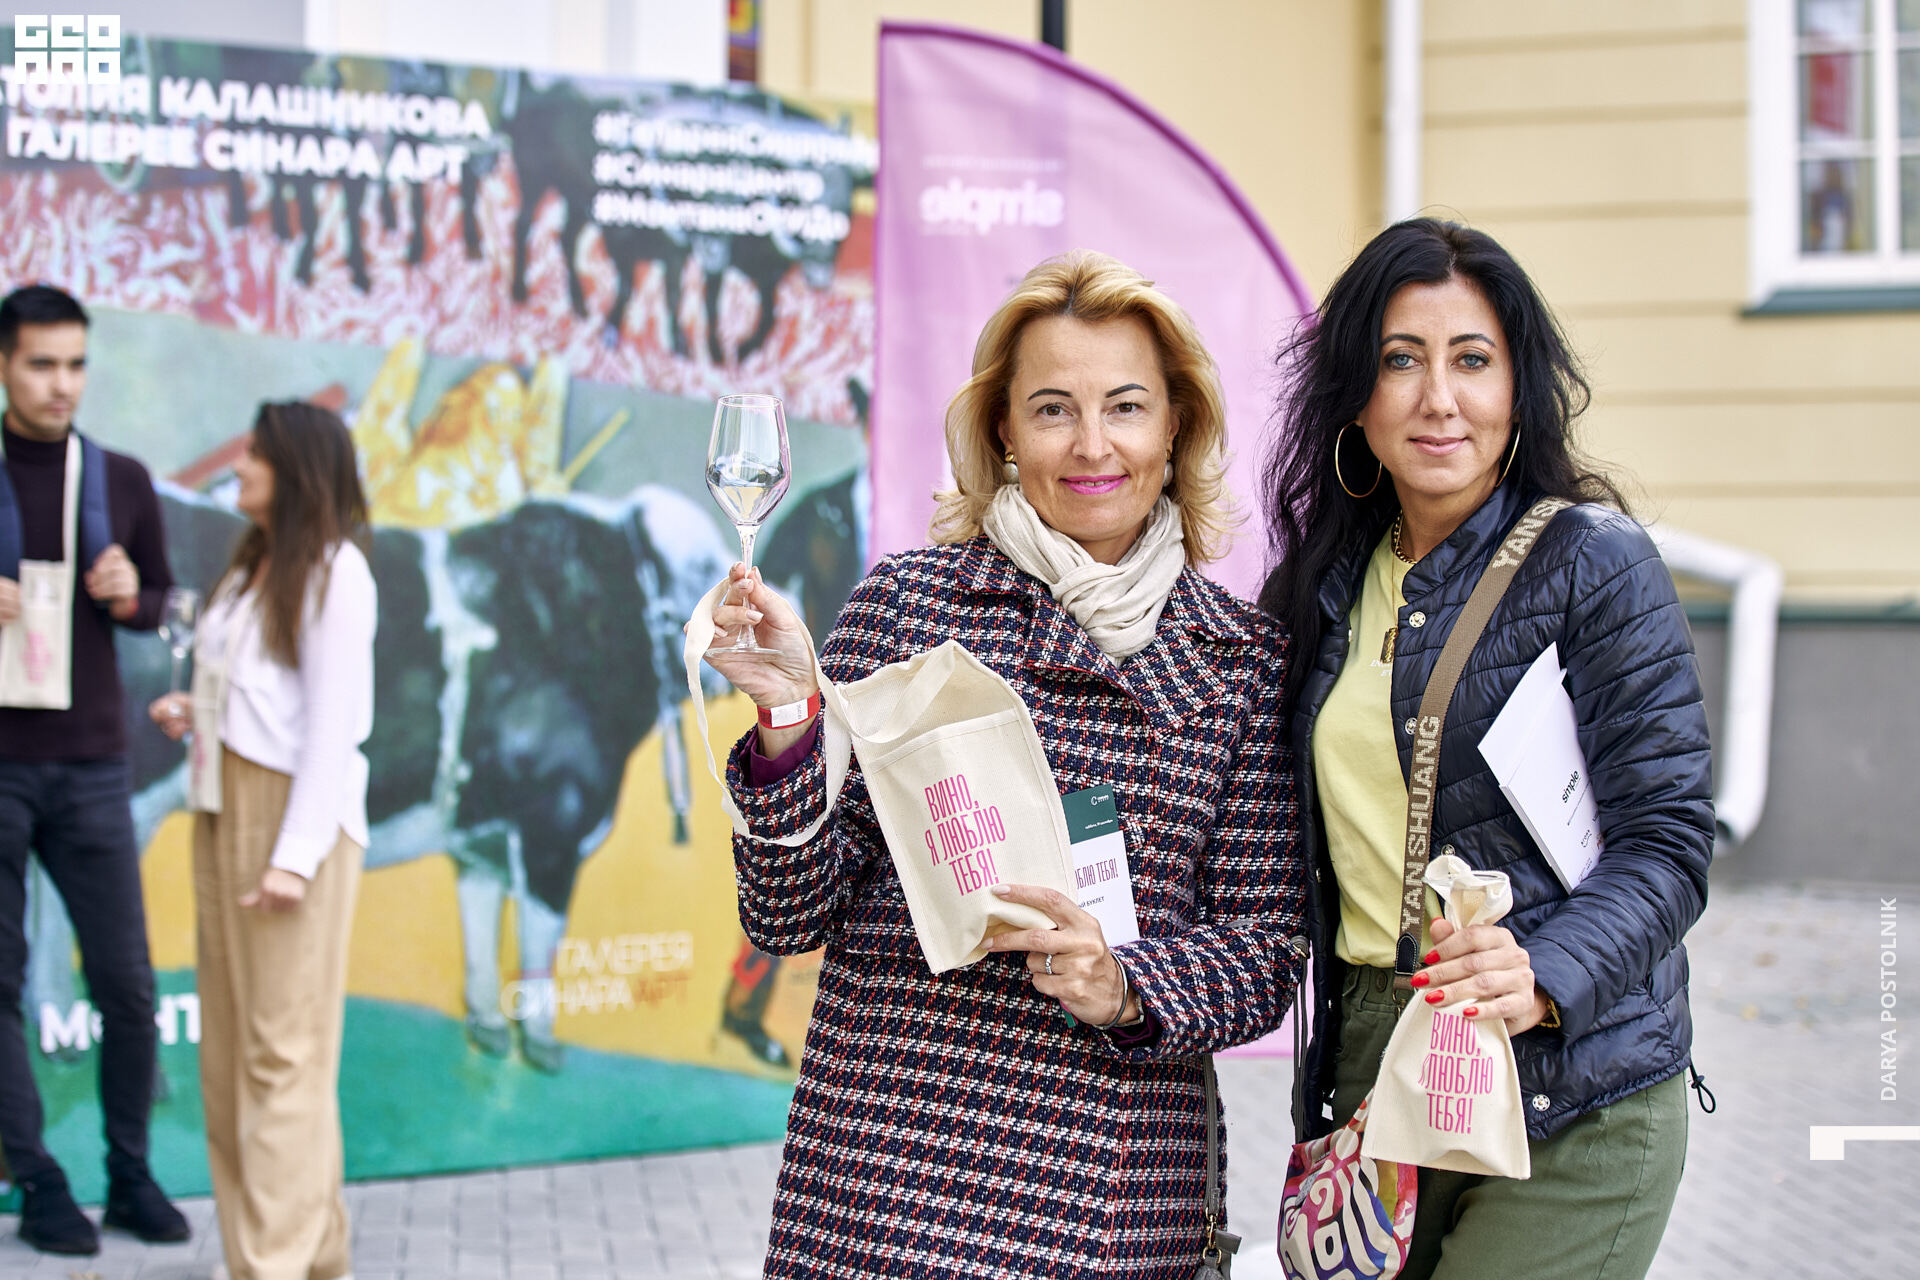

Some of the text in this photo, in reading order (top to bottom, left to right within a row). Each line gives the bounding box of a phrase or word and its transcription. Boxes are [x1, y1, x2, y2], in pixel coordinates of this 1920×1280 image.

[0, 65, 492, 140] ТОЛИЯ КАЛАШНИКОВА
[7, 114, 469, 182] ГАЛЕРЕЕ СИНАРА АРТ
[1492, 517, 1546, 569] YAN
[924, 773, 979, 823] ВИНО,
[924, 805, 1006, 867] Я ЛЮБЛЮ
[1401, 715, 1441, 932] YAN SHUANG
[948, 848, 1000, 897] ТЕБЯ!
[1095, 857, 1119, 883] ТЕБЯ!
[1430, 1011, 1481, 1057] ВИНО,
[1425, 1053, 1494, 1095] ЛЮБЛЮ
[1426, 1093, 1473, 1135] ТЕБЯ!
